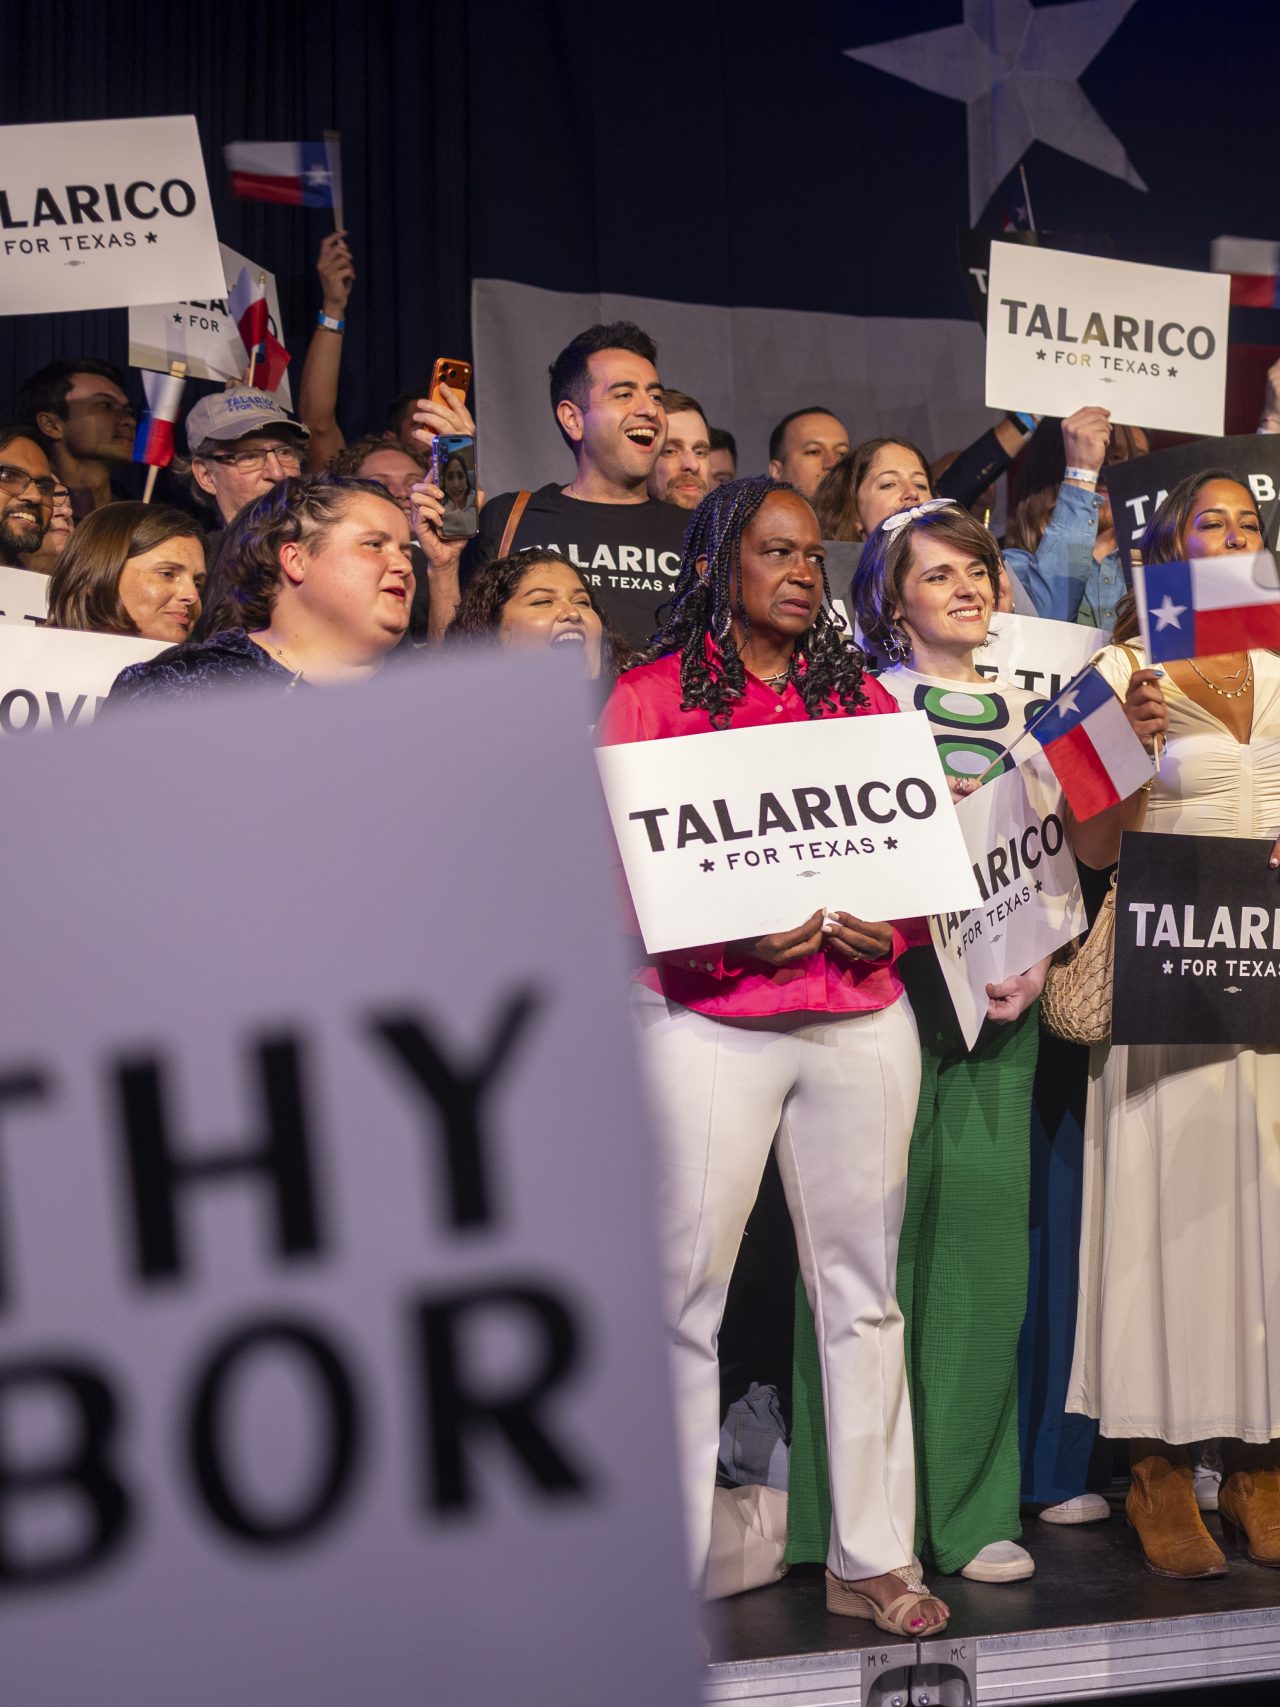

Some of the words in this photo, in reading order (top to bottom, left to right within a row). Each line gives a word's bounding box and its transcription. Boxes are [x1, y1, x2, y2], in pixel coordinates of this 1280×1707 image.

[5, 238, 51, 255] FOR
[59, 232, 137, 251] TEXAS
[189, 315, 220, 333] FOR
[1000, 298, 1215, 360] TALARICO
[1054, 351, 1091, 368] FOR
[1100, 355, 1160, 376] TEXAS
[520, 543, 681, 577] LARIC
[608, 575, 663, 592] TEXAS
[629, 777, 937, 853] TALARICO
[726, 848, 781, 870] FOR
[789, 838, 875, 861] TEXAS
[962, 920, 983, 952] FOR
[986, 886, 1031, 927] TEXAS
[1180, 959, 1217, 976] FOR
[951, 1646, 967, 1661] MC
